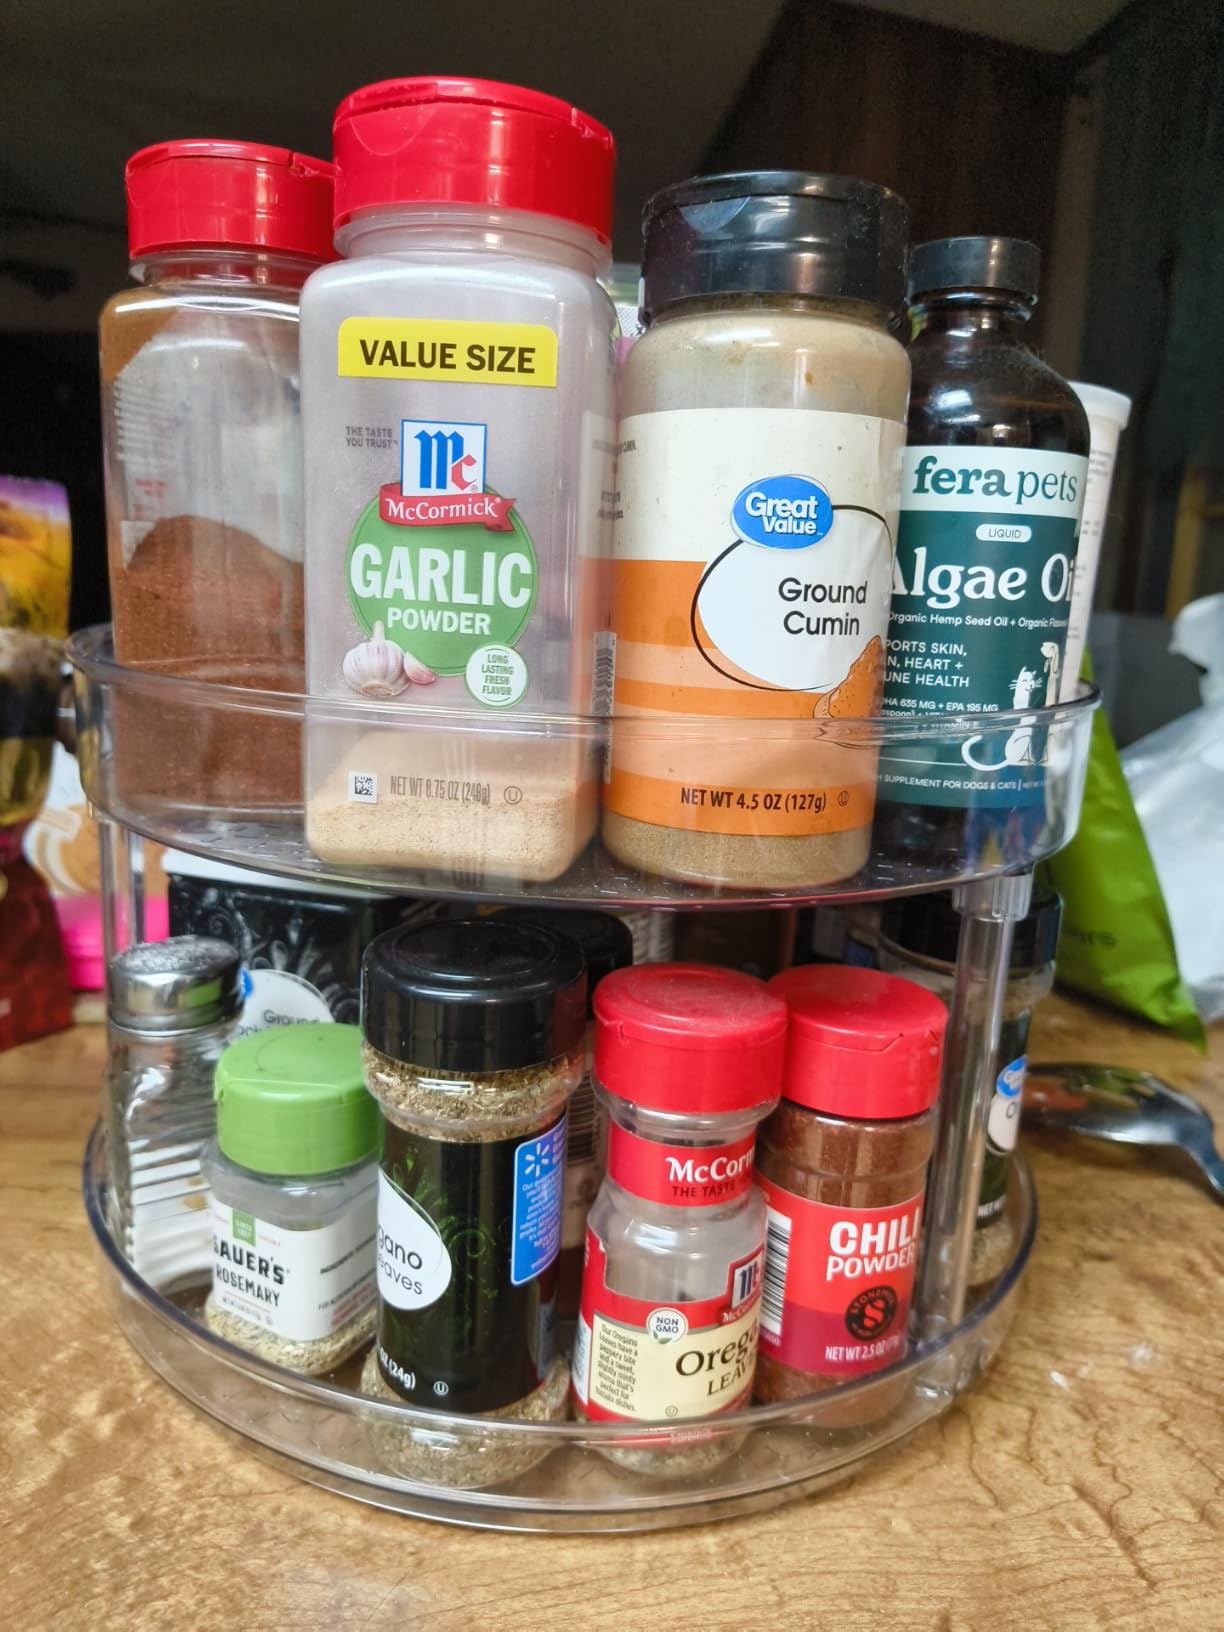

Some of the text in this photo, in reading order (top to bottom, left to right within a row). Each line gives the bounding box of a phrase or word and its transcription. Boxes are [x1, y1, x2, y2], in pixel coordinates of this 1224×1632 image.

[360, 339, 537, 375] VALUE SIZE
[346, 426, 393, 438] THE TASTE
[346, 437, 363, 447] YOU
[912, 455, 1078, 505] fera pets
[384, 497, 499, 521] McCormick
[745, 491, 819, 521] Great
[762, 515, 817, 535] Value
[988, 527, 1022, 539] LIQUID
[350, 543, 533, 608] GARLIC
[1041, 552, 1075, 602] Oi
[778, 577, 868, 604] Ground
[387, 607, 491, 635] POWDER
[783, 610, 860, 636] Cumin
[930, 614, 962, 627] Hemp
[965, 616, 991, 626] Seed
[993, 616, 1007, 627] Oil
[1018, 617, 1048, 630] Organic
[930, 642, 968, 657] SKIN,
[481, 664, 514, 675] LASTING
[904, 657, 951, 670] HEART
[485, 674, 510, 686] FRESH
[884, 671, 970, 688] UNE HEALTH
[482, 685, 512, 696] FLAVOR
[919, 700, 936, 710] MG
[946, 701, 965, 712] EPA
[966, 703, 981, 712] 195
[982, 704, 999, 713] MG
[390, 775, 407, 796] NET
[409, 777, 423, 797] WT
[425, 778, 445, 799] 8.75
[447, 780, 460, 800] OZ
[883, 774, 942, 788] SUPPLEMENT
[942, 780, 961, 789] FOR
[963, 780, 989, 790] DOGS
[997, 781, 1017, 790] CATS
[681, 787, 827, 814] NET WT 4.5 OZ (127g)
[672, 1185, 697, 1198] THE
[702, 1180, 735, 1197] TASTE
[830, 1207, 920, 1256] CHILI
[826, 1242, 916, 1282] POWDER
[216, 1263, 280, 1307] ROSEMARY
[655, 1324, 679, 1334] GMO
[656, 1316, 679, 1326] NON
[612, 1330, 638, 1347] Oregano
[825, 1345, 843, 1361] NET
[844, 1345, 861, 1361] WT
[861, 1343, 876, 1360] 2.5
[388, 1358, 416, 1391] (24g)
